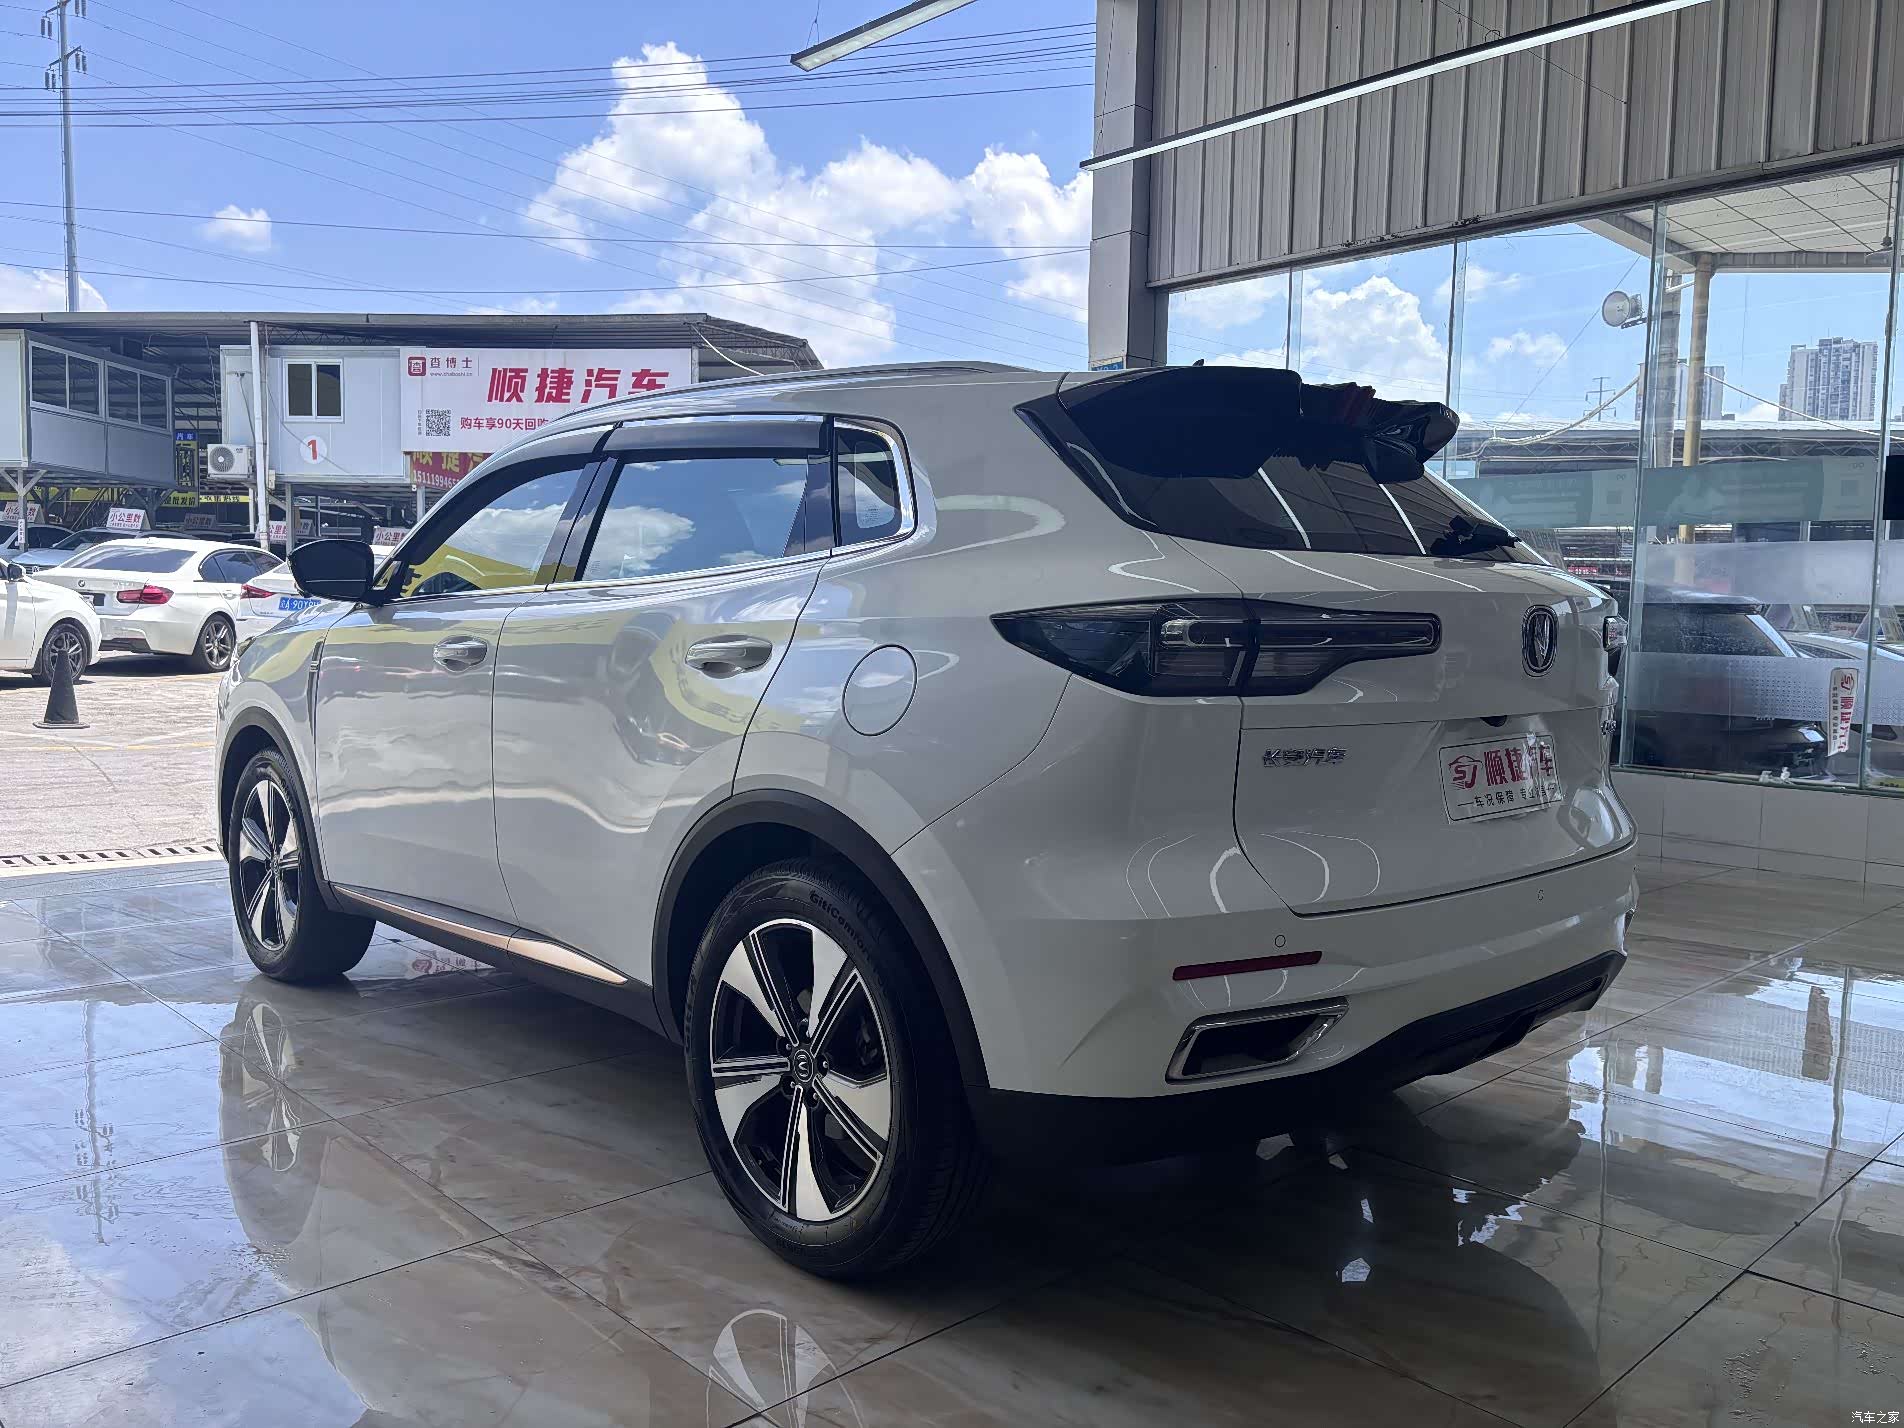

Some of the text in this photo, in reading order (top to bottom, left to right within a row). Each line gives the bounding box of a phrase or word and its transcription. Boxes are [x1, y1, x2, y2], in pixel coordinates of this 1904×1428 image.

[429, 357, 473, 369] 查博士
[307, 439, 318, 461] 1
[109, 512, 142, 524] 小公里数
